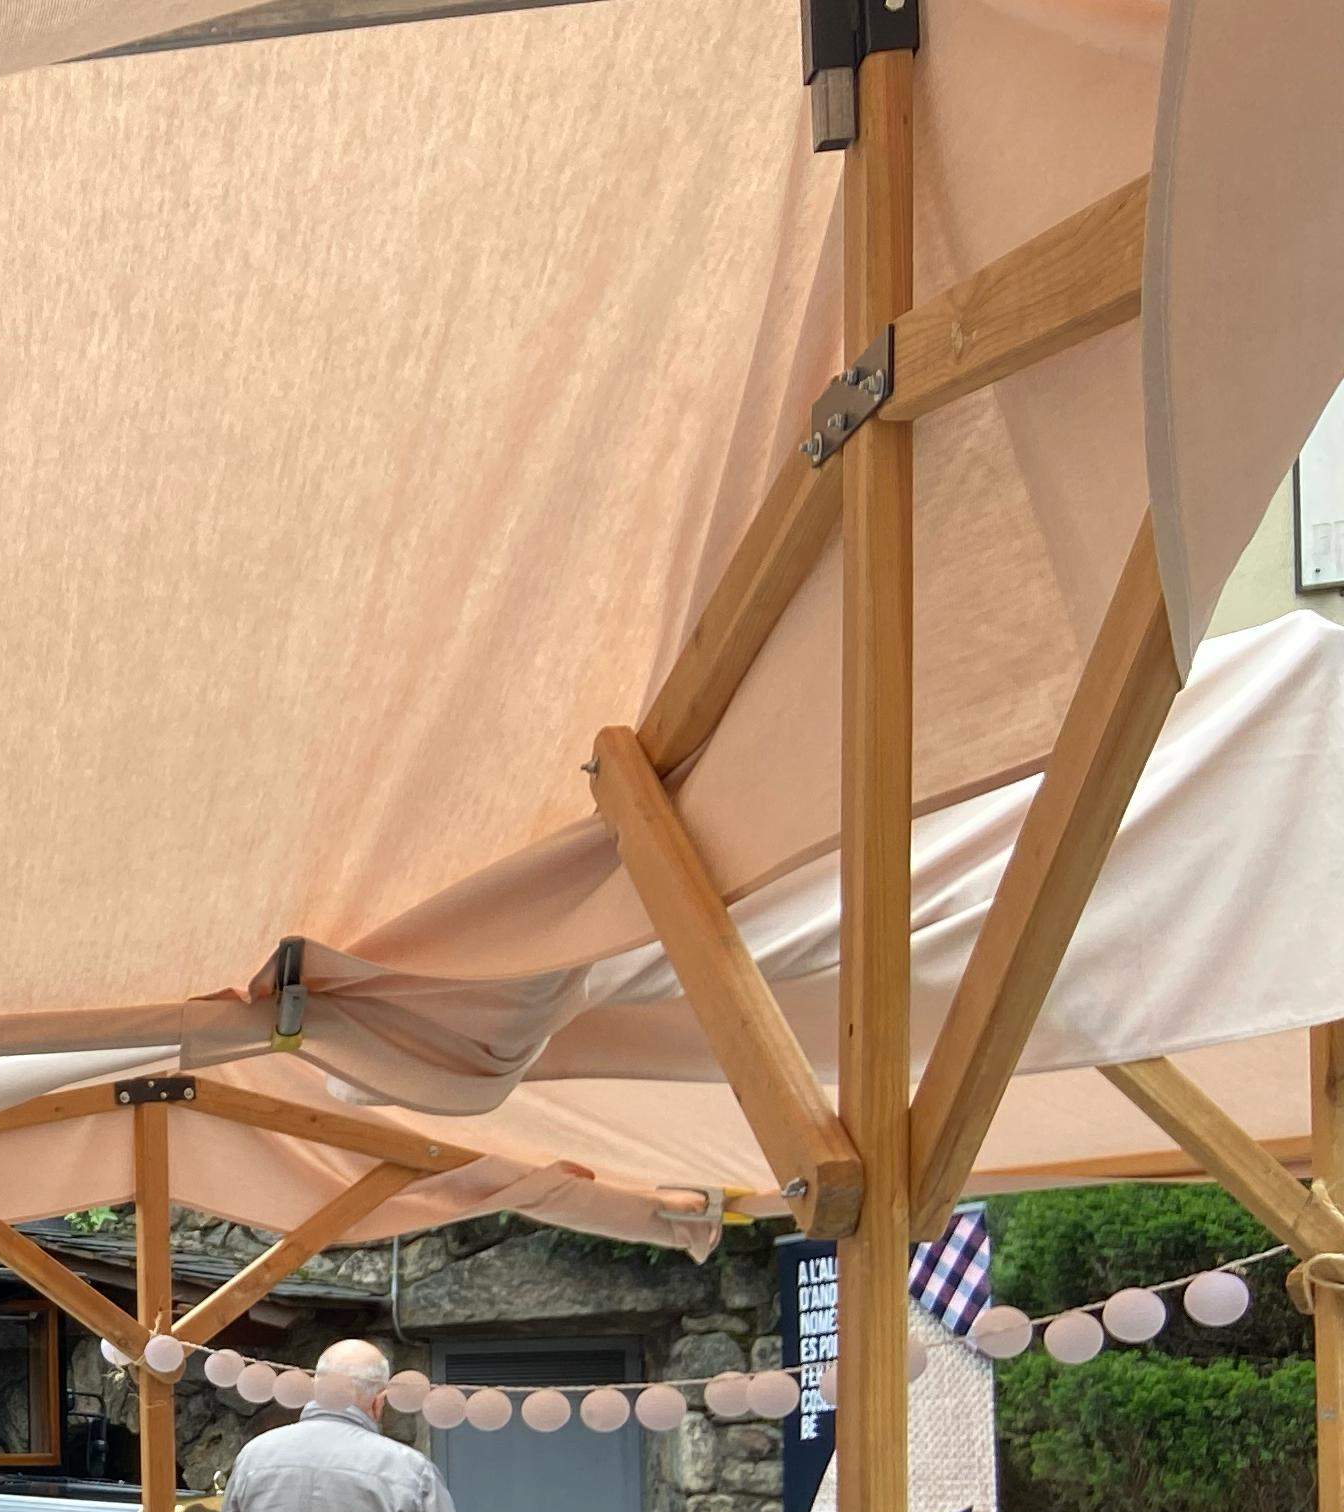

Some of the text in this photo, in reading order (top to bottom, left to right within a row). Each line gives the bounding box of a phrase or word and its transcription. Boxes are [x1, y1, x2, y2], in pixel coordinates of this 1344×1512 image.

[798, 1256, 839, 1285] A L'AL
[799, 1281, 839, 1312] D'AND
[800, 1337, 818, 1364] ES
